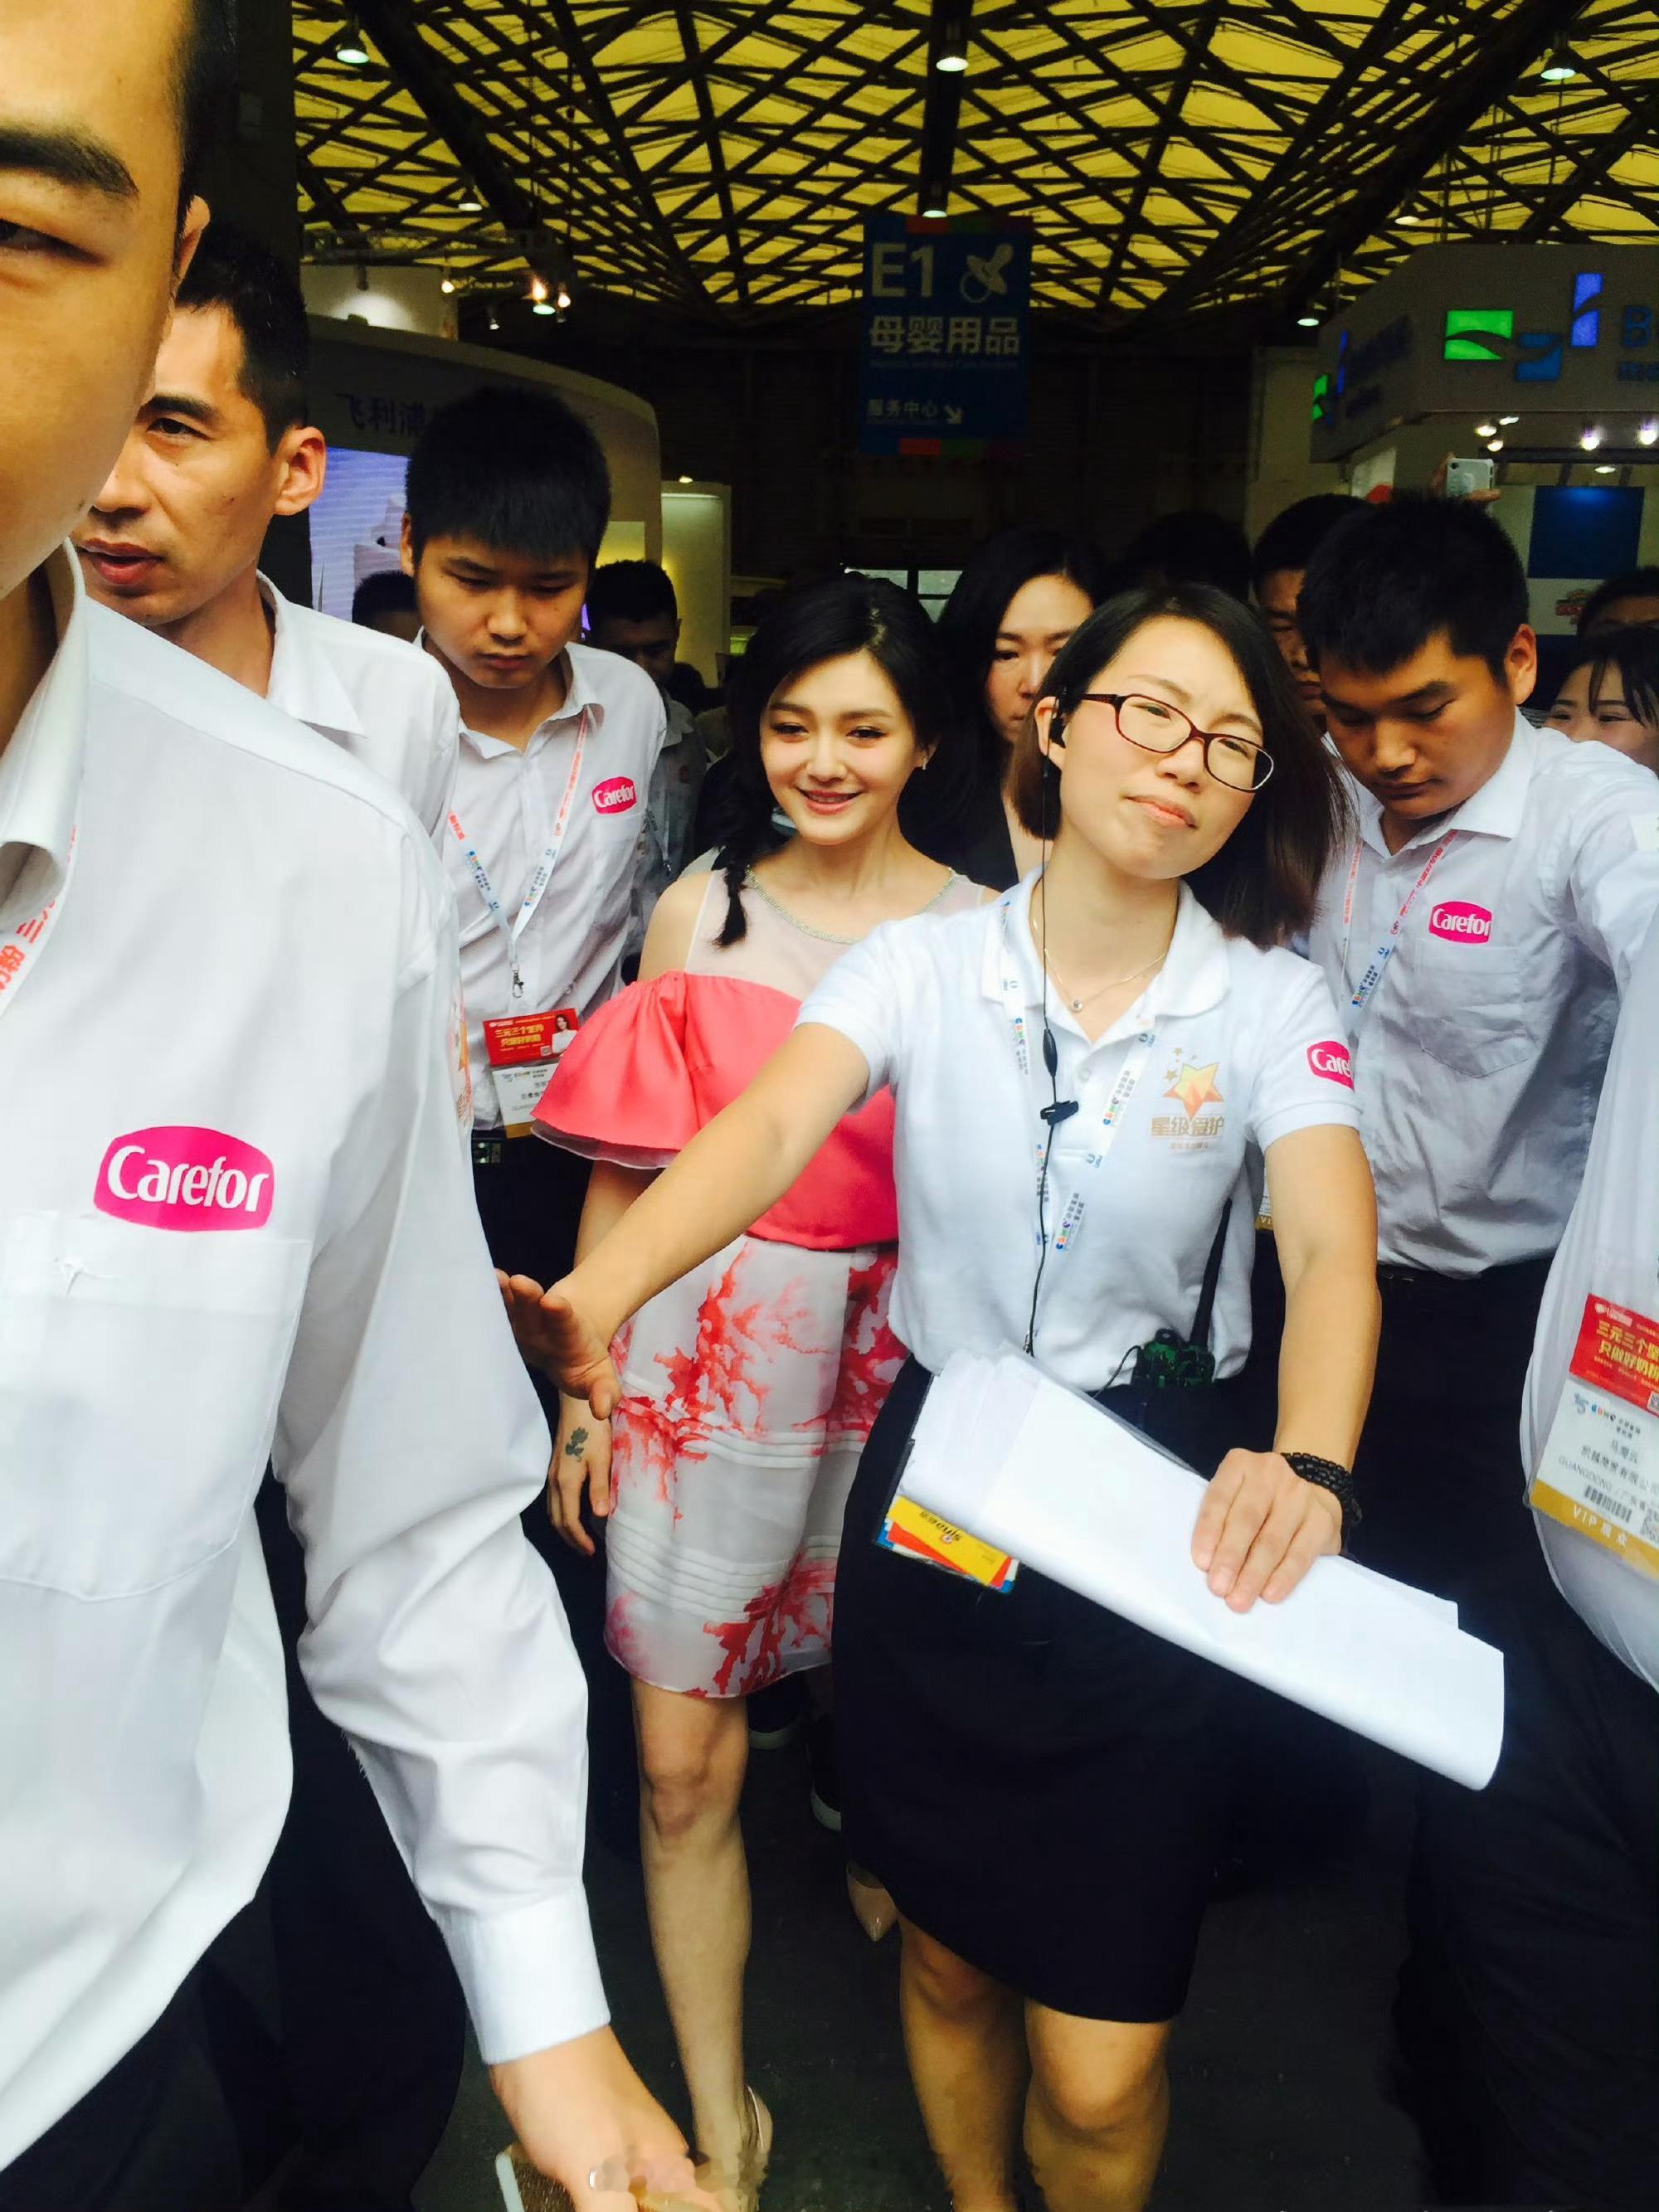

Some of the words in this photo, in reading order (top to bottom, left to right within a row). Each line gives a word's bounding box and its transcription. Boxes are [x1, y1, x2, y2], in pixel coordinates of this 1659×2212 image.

[873, 243, 934, 298] E1
[870, 315, 1020, 355] 母婴用品
[868, 399, 937, 417] 服务中心
[593, 785, 635, 809] Carefor
[1433, 908, 1492, 936] Carefor
[1311, 1048, 1351, 1078] Care
[107, 1145, 270, 1213] Carefor
